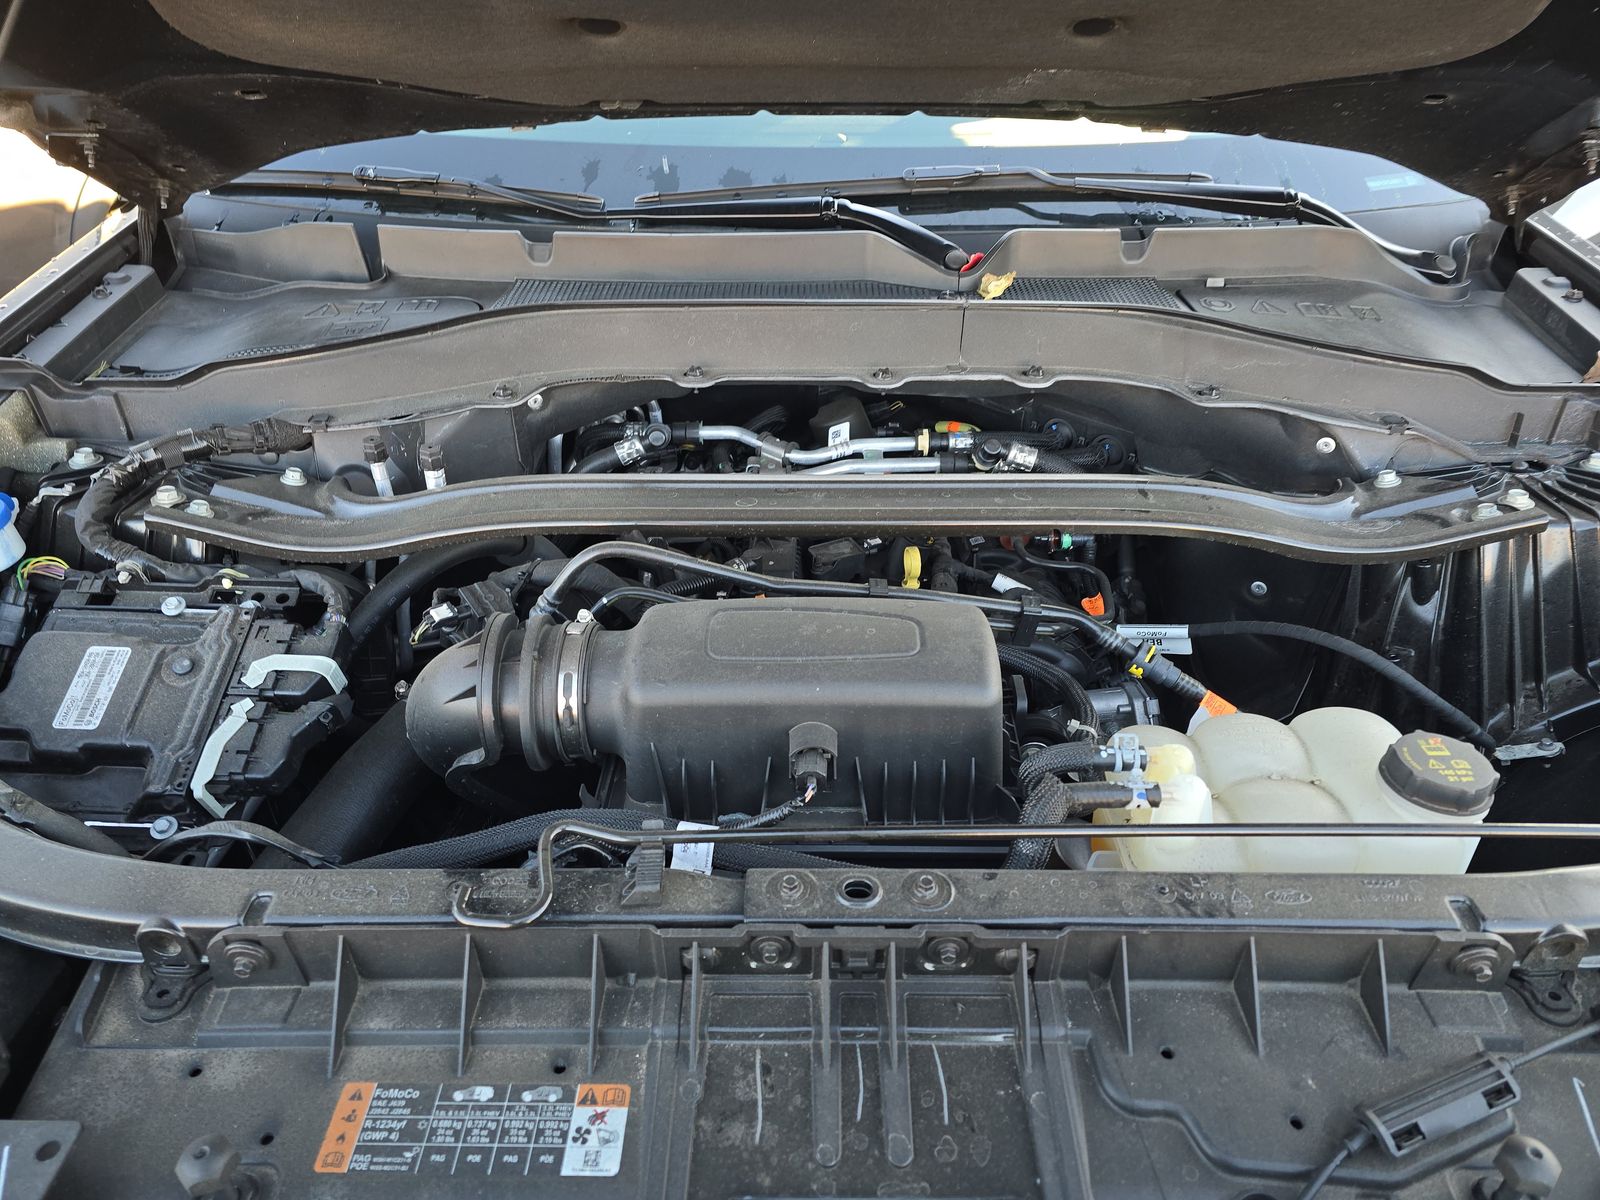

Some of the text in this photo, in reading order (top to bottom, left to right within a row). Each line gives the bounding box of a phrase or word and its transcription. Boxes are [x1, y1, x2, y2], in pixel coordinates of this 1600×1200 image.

[89, 698, 102, 718] BOSCH
[374, 1088, 420, 1099] FoMoCo
[364, 1120, 407, 1130] R-1234yf
[453, 1120, 462, 1130] kg
[488, 1120, 497, 1130] kg
[526, 1120, 534, 1130] kg
[560, 1120, 569, 1130] kg
[360, 1131, 400, 1142] (GWP 4)
[352, 1154, 372, 1162] PAG
[430, 1154, 446, 1162] PAG
[466, 1154, 482, 1162] POE
[502, 1154, 518, 1162] PAG
[539, 1154, 554, 1163] POE
[350, 1162, 369, 1170] POE
